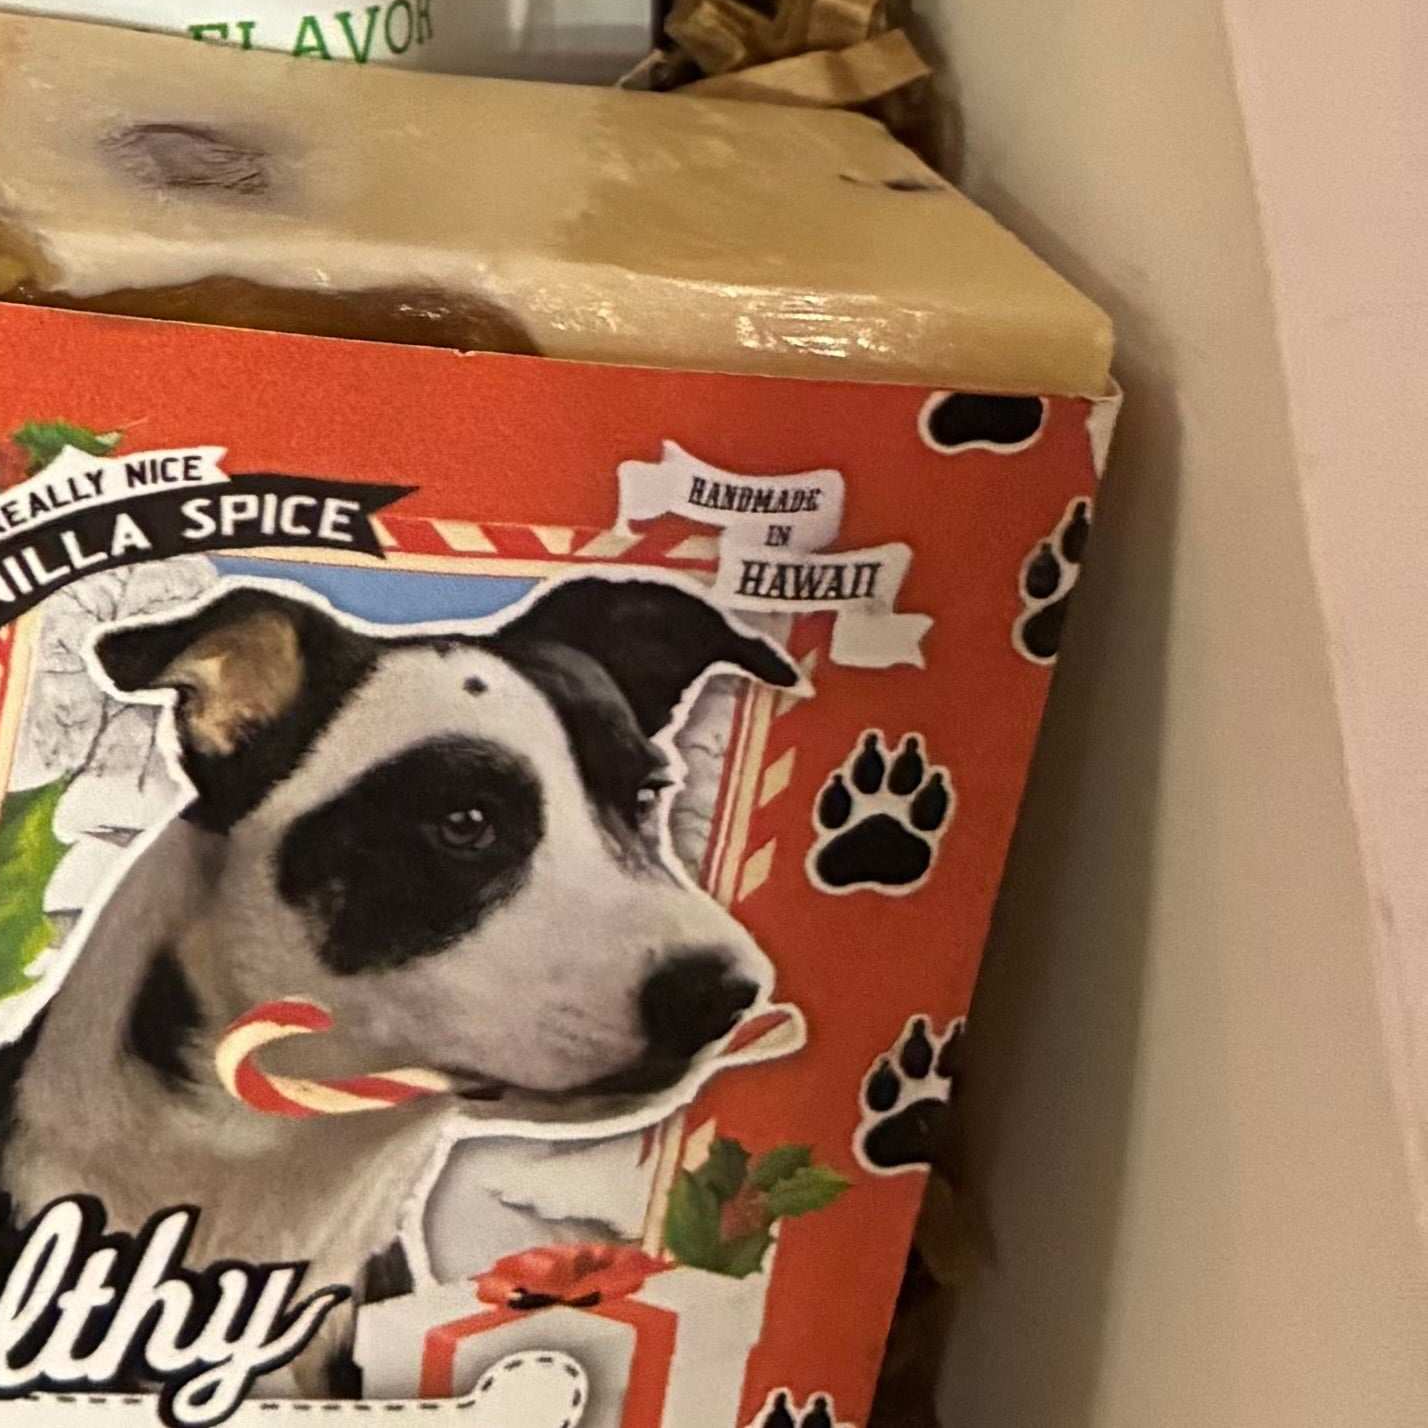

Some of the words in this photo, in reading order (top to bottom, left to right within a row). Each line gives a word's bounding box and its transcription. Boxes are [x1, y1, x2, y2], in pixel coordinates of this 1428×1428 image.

[125, 455, 204, 488] NICE
[687, 476, 822, 513] HANDMADE
[181, 492, 361, 543] SPICE
[764, 524, 793, 547] IN
[735, 560, 883, 601] HAWAII
